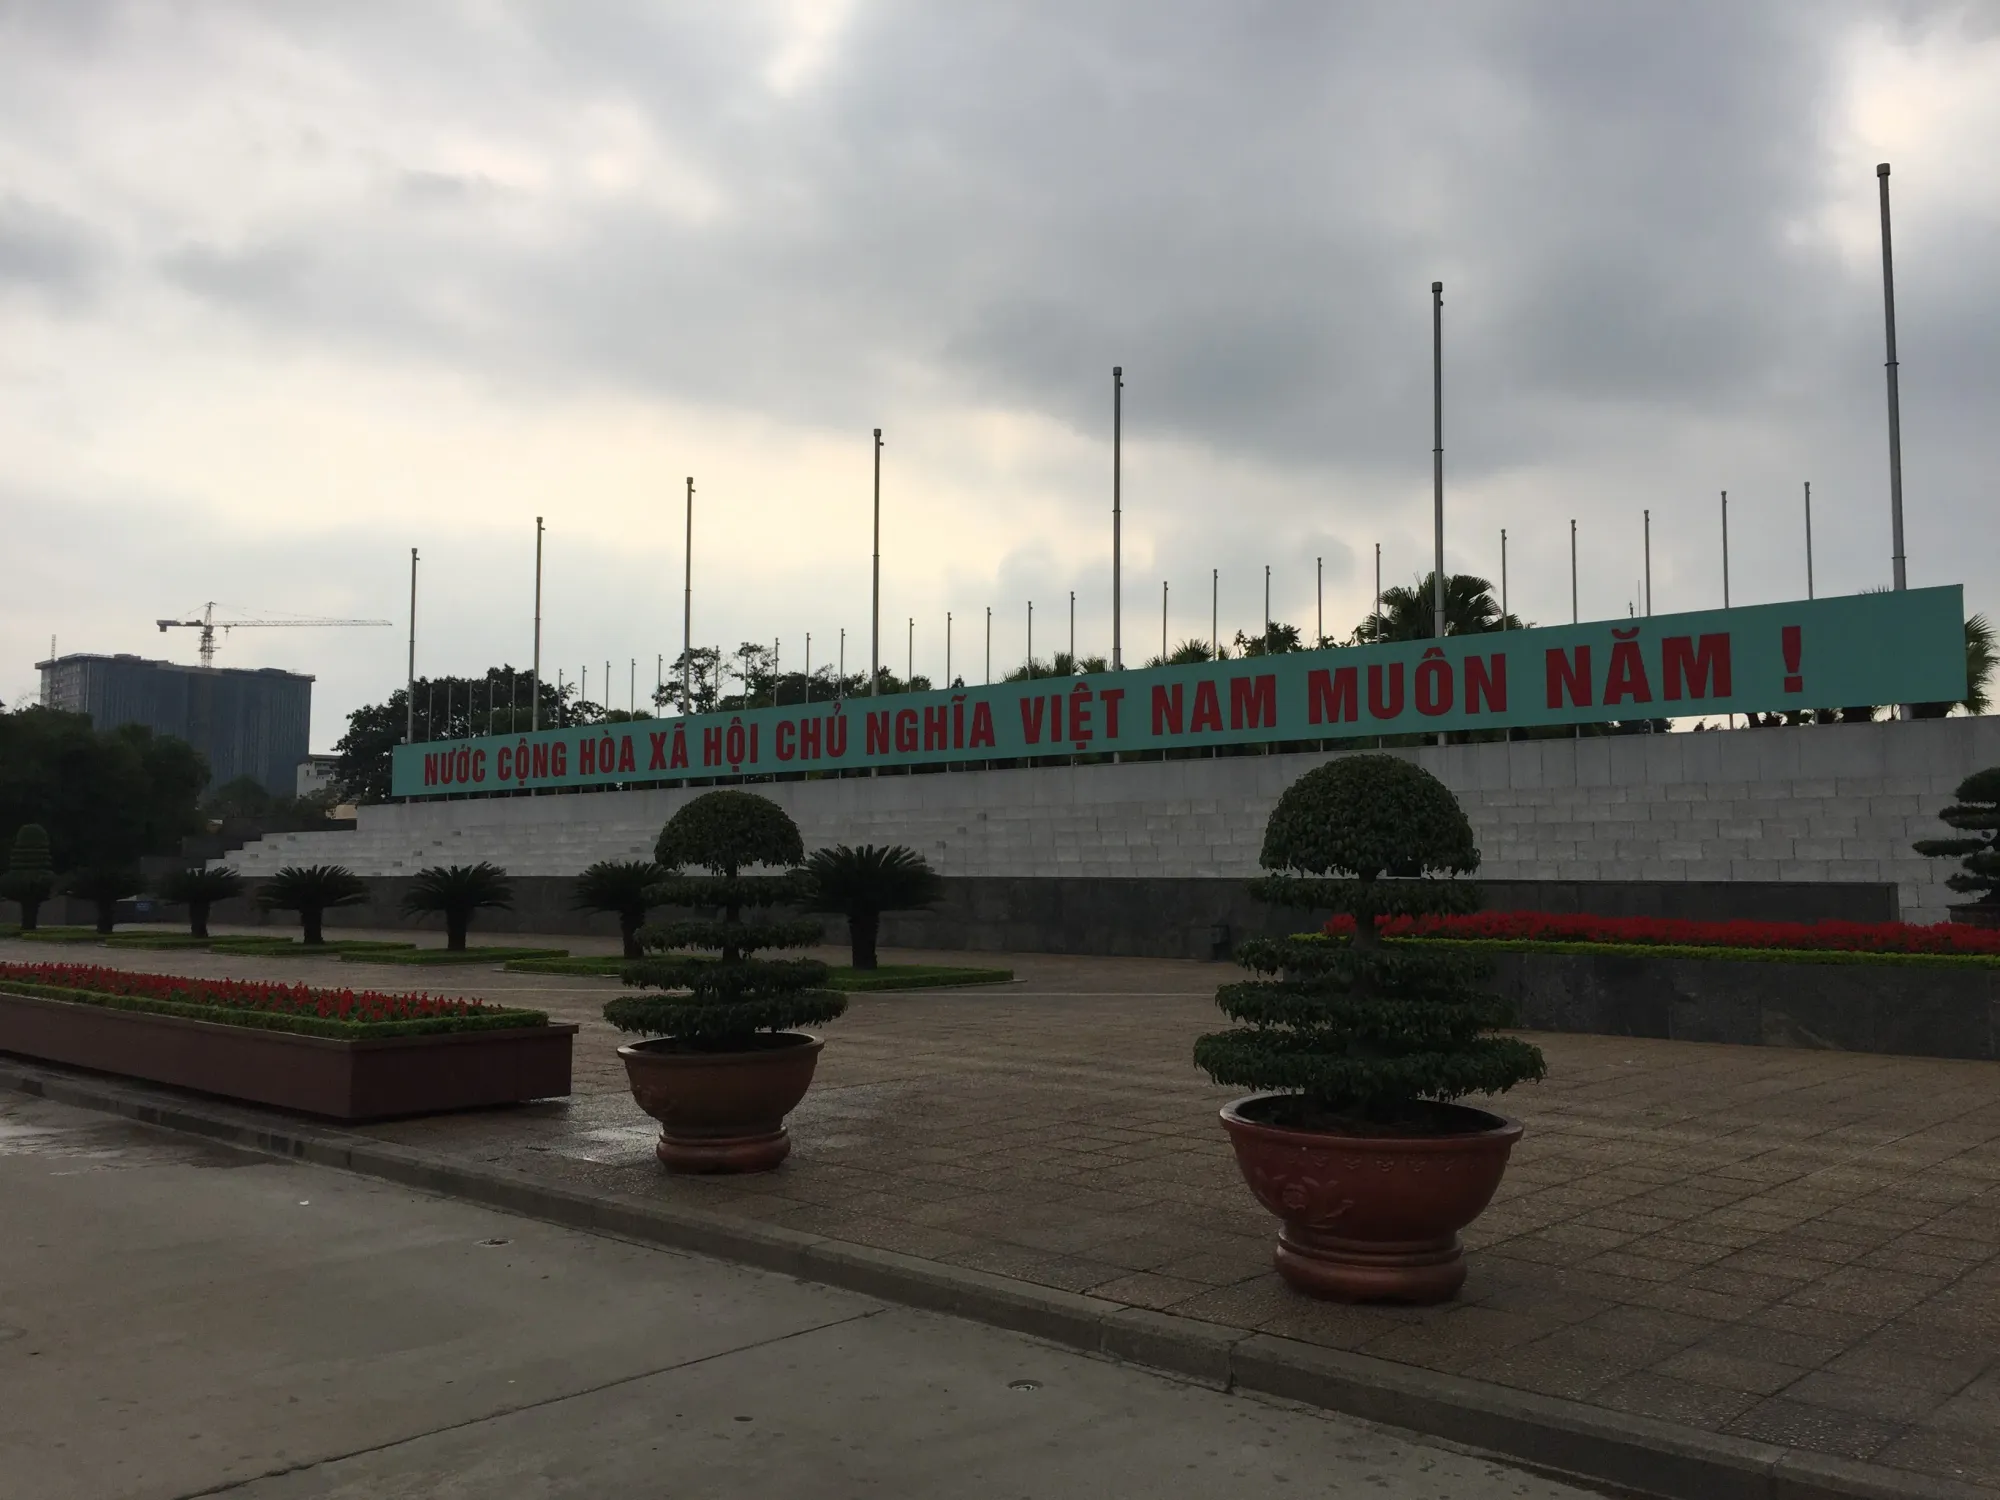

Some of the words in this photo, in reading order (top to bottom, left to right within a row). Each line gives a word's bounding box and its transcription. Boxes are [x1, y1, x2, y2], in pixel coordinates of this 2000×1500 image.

[424, 742, 486, 786] NƯỚC
[497, 737, 567, 787] CỘNG
[579, 729, 636, 775] HÒA
[649, 722, 689, 770] XÃ
[703, 716, 758, 773] HỘI
[775, 702, 847, 761] CHỦ
[866, 694, 996, 755] NGHĨA
[1020, 682, 1125, 751] VIỆT
[1151, 674, 1277, 736] NAM
[1307, 647, 1508, 725] MUÔN
[1545, 627, 1733, 709] NĂM
[1781, 625, 1803, 693] !
